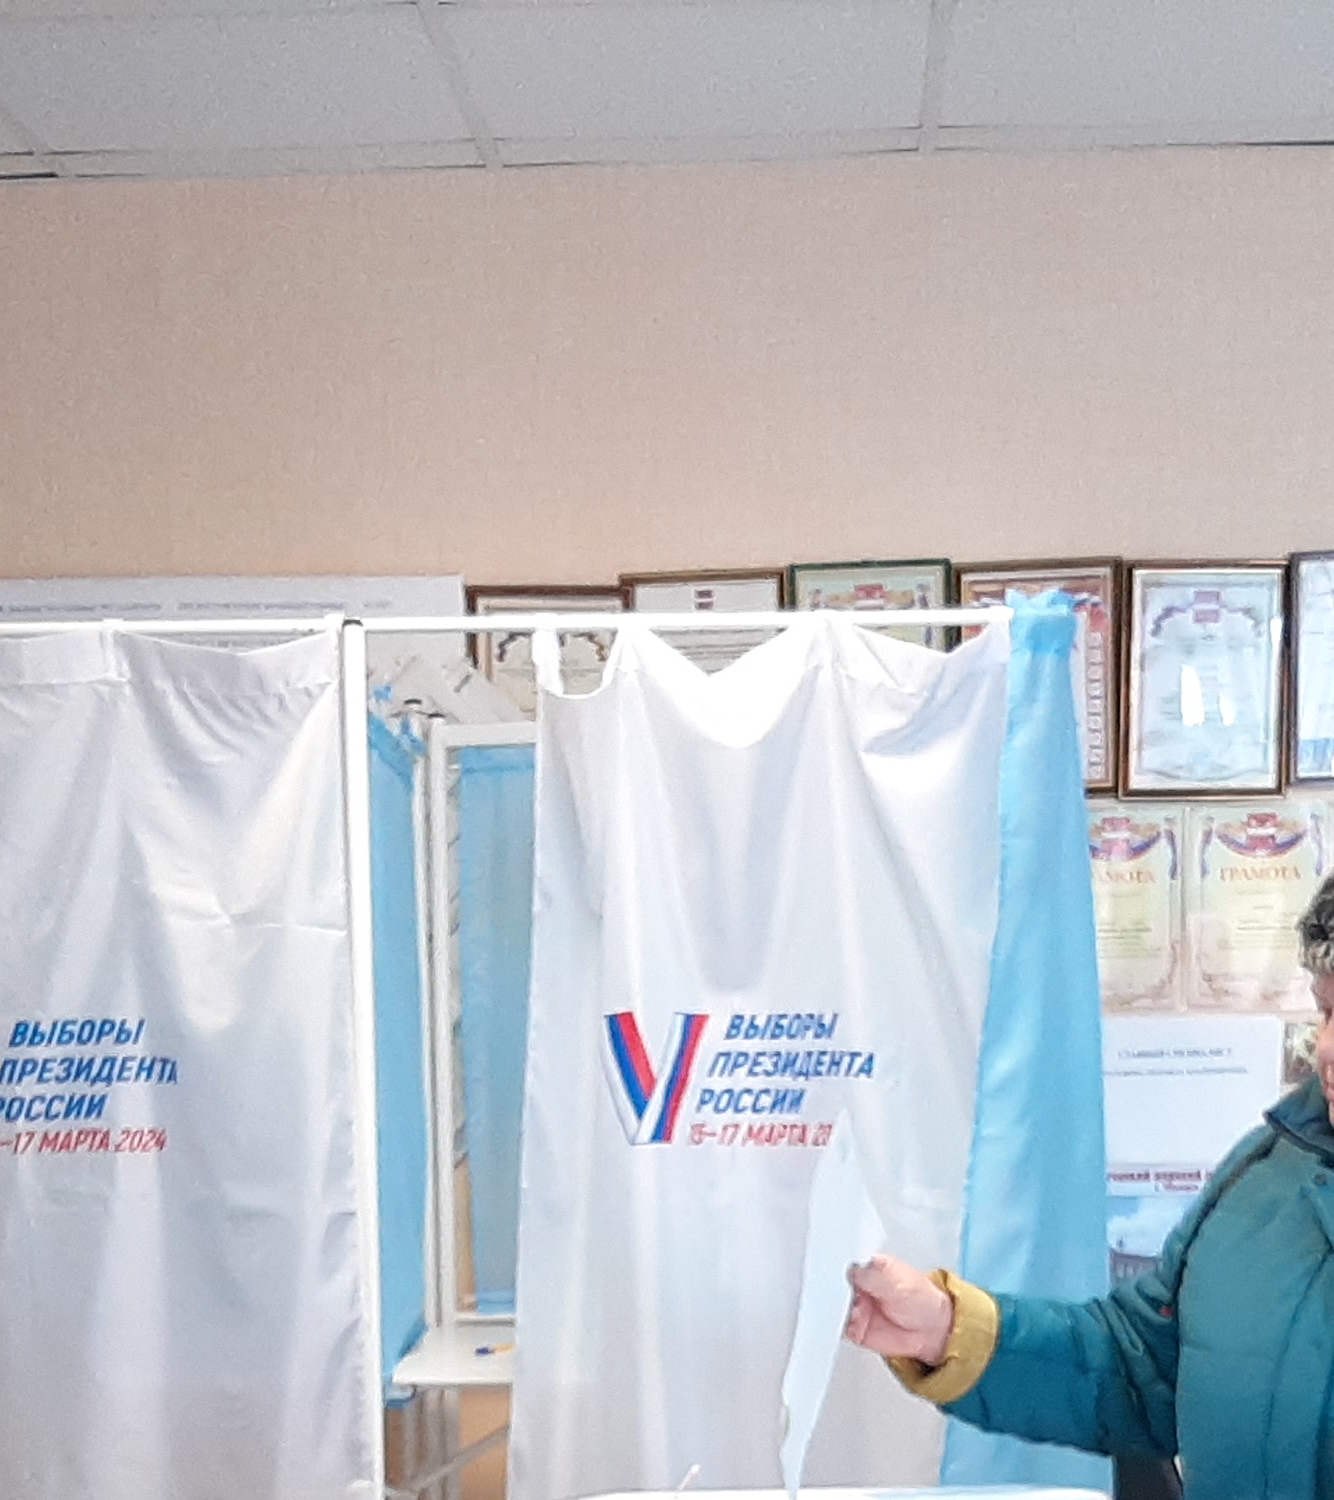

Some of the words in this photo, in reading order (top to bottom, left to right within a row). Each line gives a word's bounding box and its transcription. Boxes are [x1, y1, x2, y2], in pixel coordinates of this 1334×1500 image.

[9, 1019, 145, 1047] ВЫБОРЫ
[723, 1014, 839, 1040] ВЫБОРЫ
[707, 1051, 876, 1080] ПРЕЗИДЕНТА
[695, 1088, 807, 1115] РОССИИ
[38, 1129, 111, 1153] МАРТА
[114, 1129, 167, 1152] 2024
